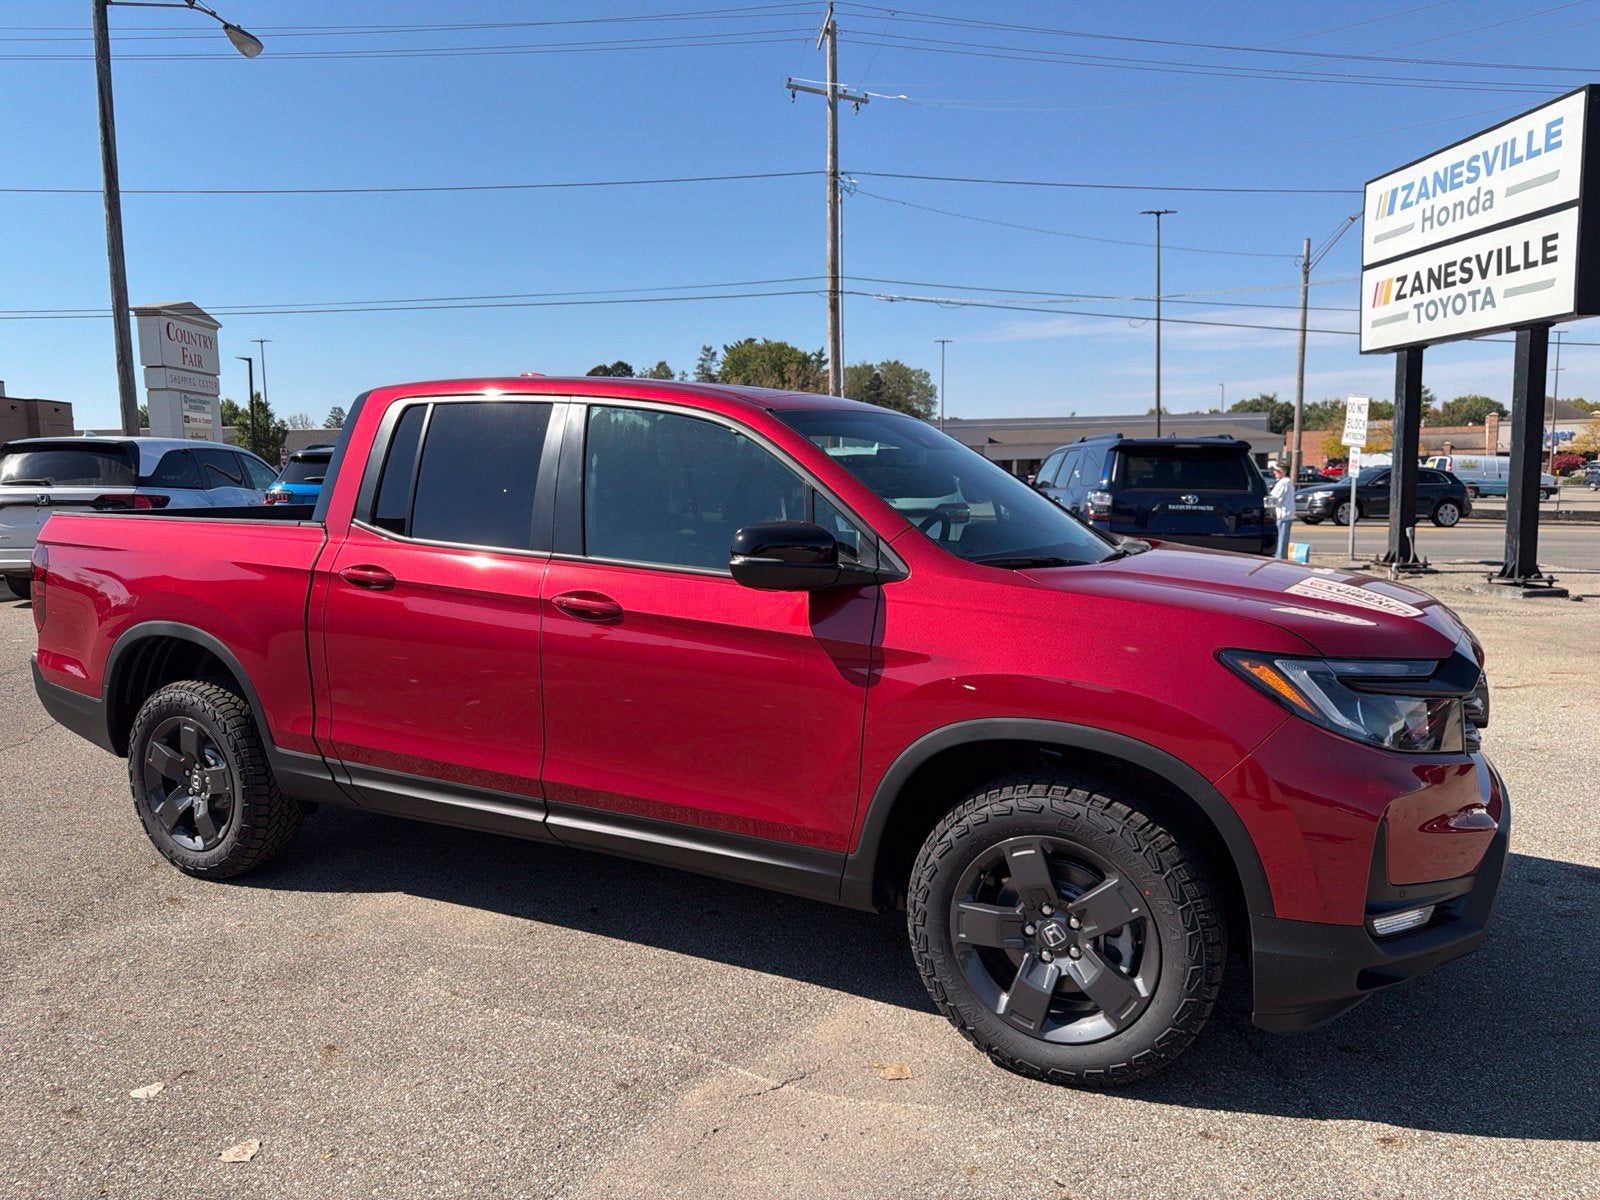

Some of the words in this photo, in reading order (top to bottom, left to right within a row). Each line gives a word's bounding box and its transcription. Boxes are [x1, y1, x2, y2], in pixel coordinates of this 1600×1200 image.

[1400, 116, 1564, 211] ZANESVILLE
[1421, 186, 1495, 233] Honda
[1394, 232, 1559, 302] ZANESVILLE
[1413, 286, 1497, 324] TOYOTA
[166, 321, 214, 350] COUNTRY
[181, 347, 204, 368] FAIR
